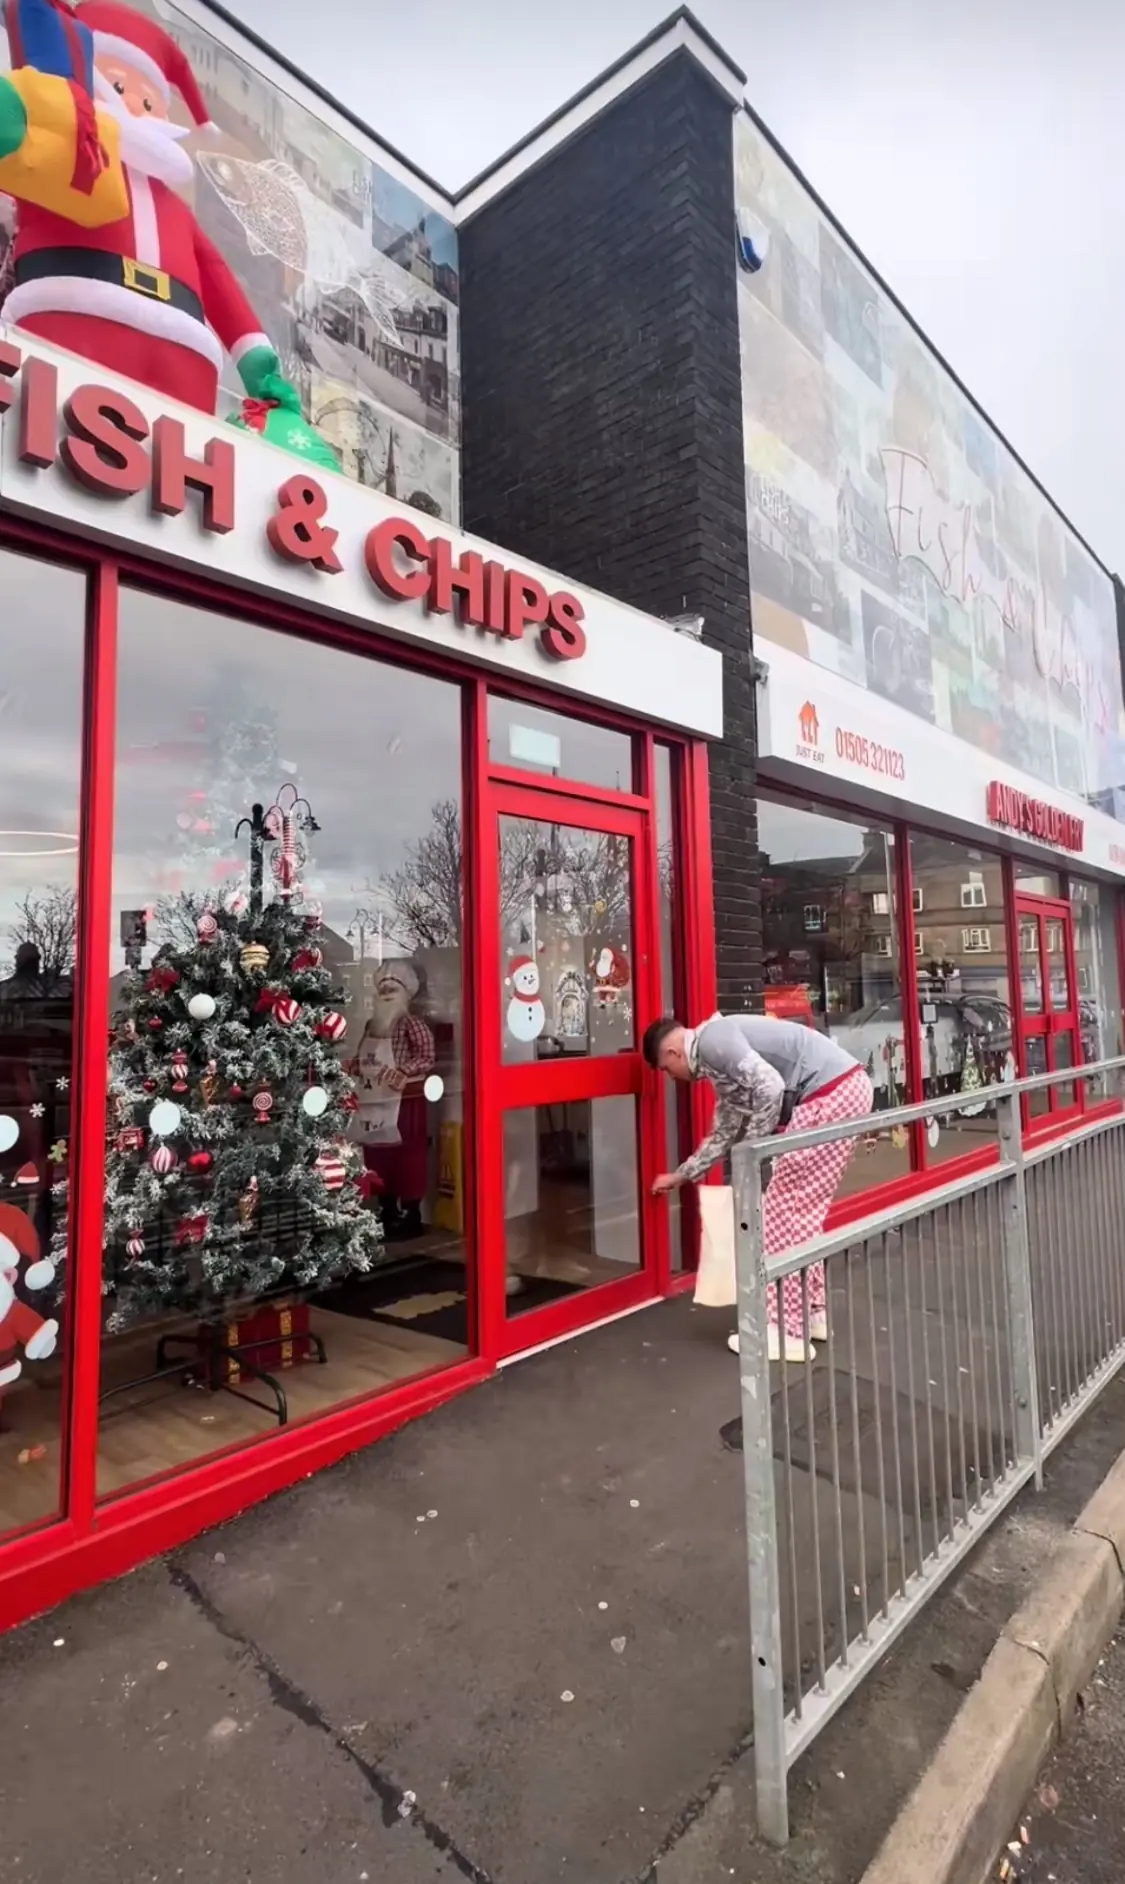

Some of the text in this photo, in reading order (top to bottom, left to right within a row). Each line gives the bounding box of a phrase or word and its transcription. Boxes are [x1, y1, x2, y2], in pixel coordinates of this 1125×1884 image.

[266, 474, 344, 575] &
[364, 516, 587, 661] CHIPS
[881, 447, 982, 602] Fish
[795, 744, 826, 764] JUST EAT
[835, 726, 905, 780] 01505 321123
